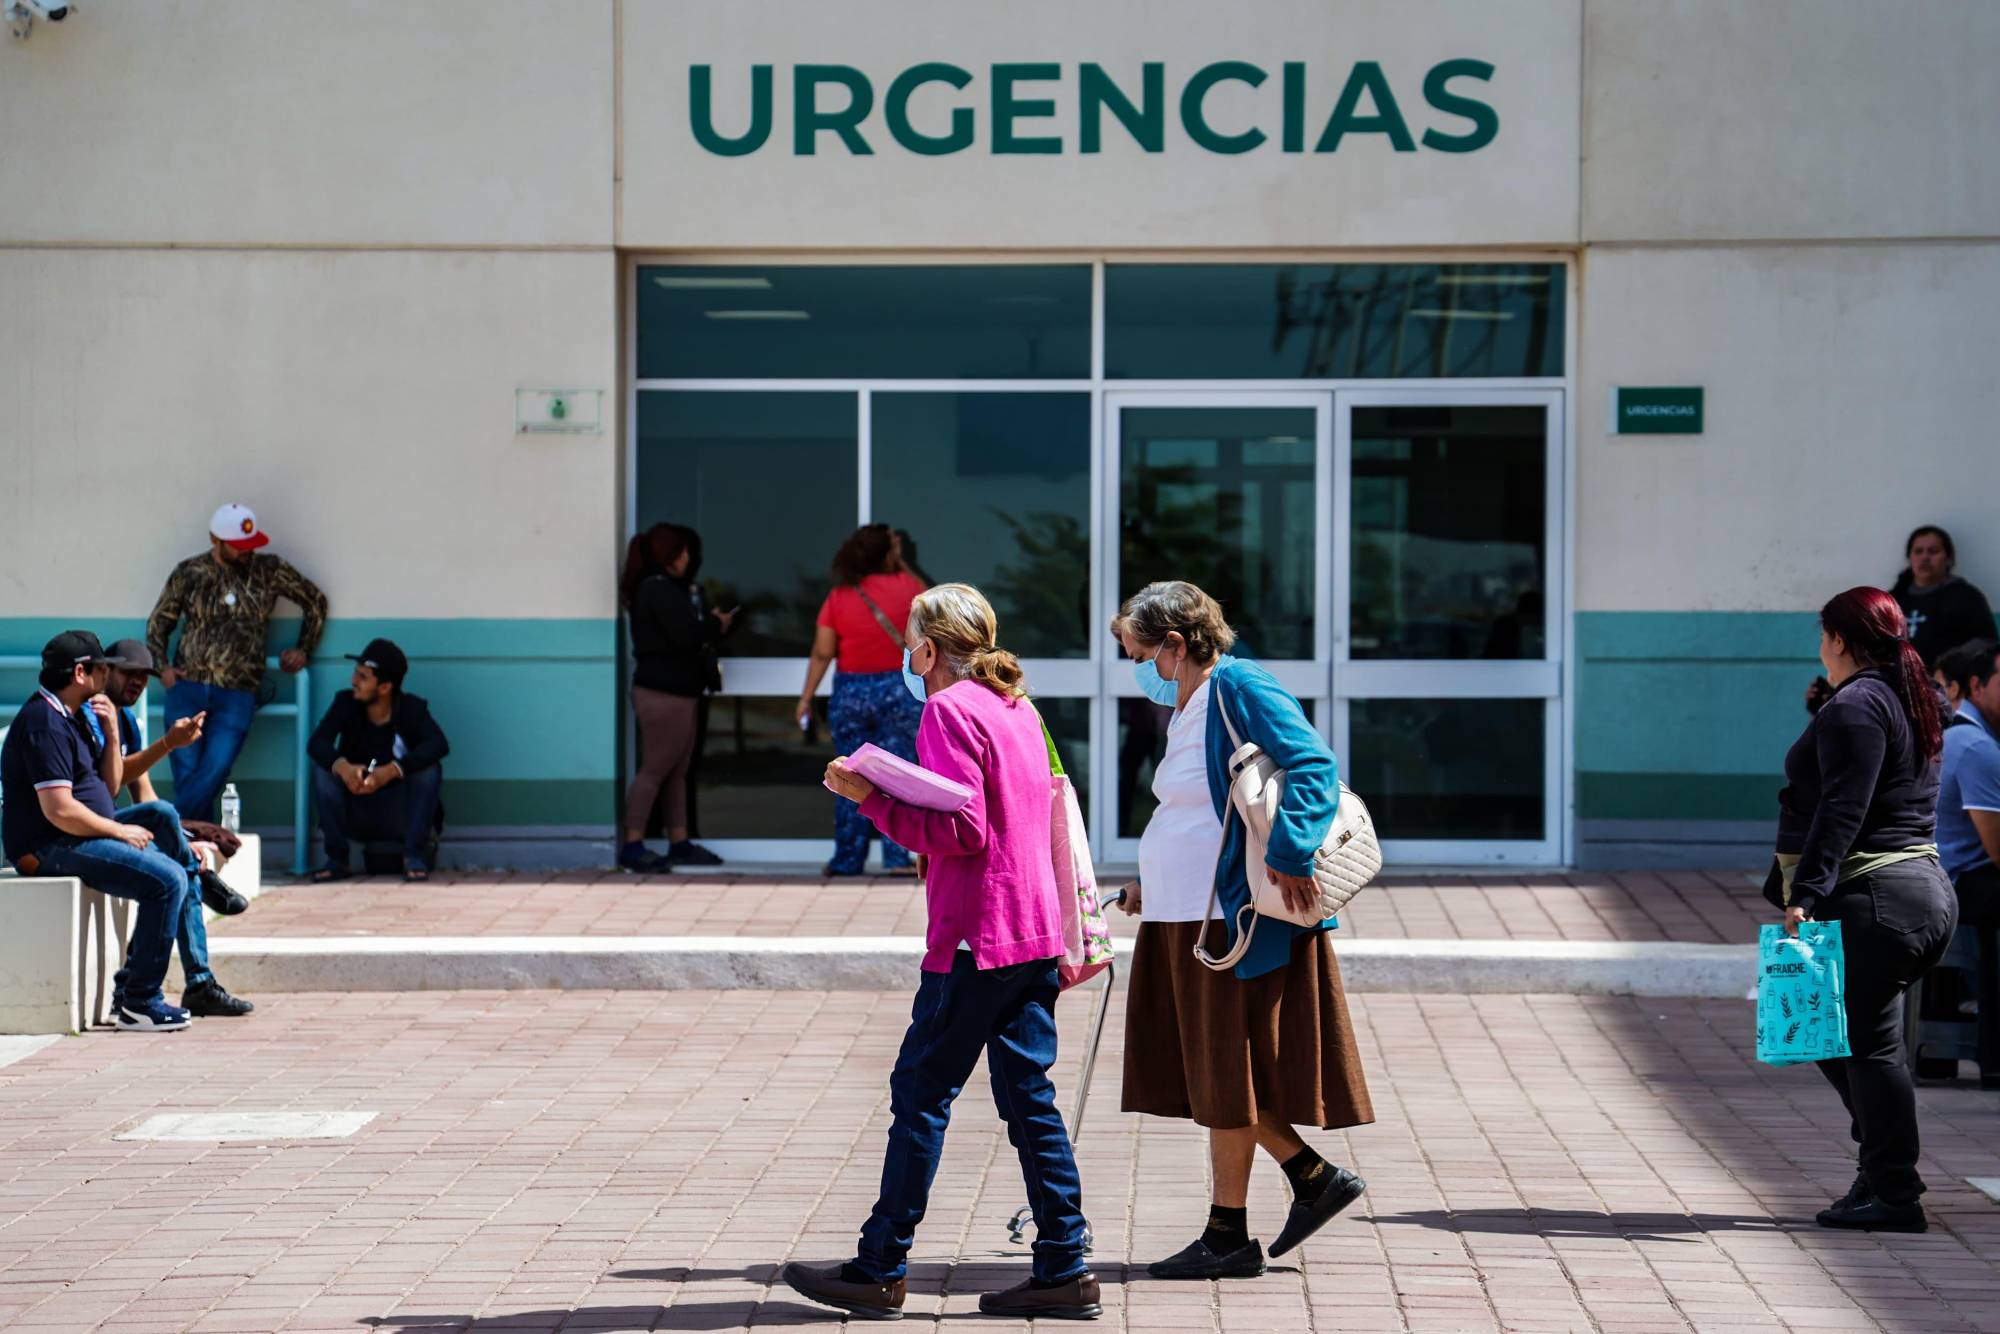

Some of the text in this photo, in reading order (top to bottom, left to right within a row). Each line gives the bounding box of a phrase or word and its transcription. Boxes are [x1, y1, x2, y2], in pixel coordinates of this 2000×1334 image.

[689, 58, 1498, 157] URGENCIAS
[1626, 404, 1696, 416] URGENCIAS
[1773, 963, 1807, 974] FRAICHE
